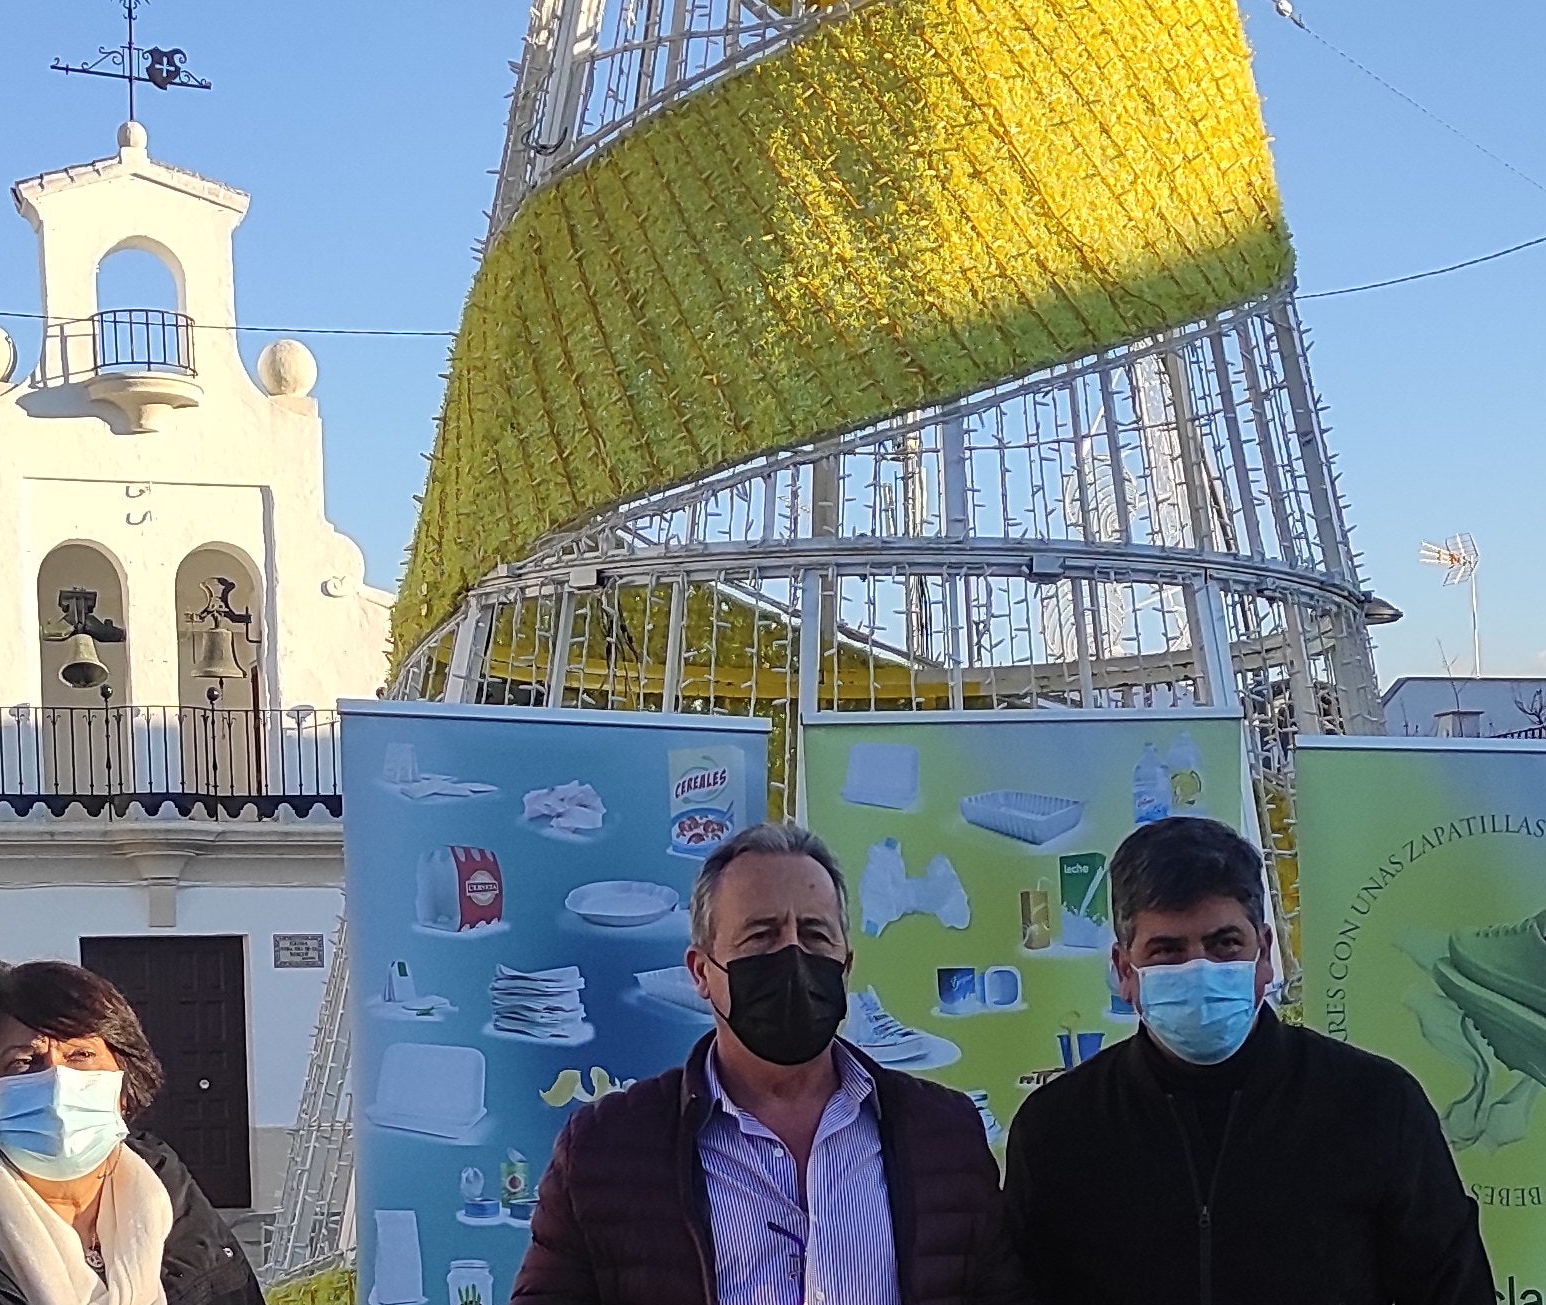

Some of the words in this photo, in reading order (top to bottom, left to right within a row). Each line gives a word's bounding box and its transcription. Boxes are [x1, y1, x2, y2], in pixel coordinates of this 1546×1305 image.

[675, 768, 727, 799] CEREALES
[1402, 814, 1546, 863] ZAPATILLAS
[1351, 854, 1404, 915] UNAS
[1329, 919, 1360, 980] CON
[1327, 988, 1348, 1041] RES
[1470, 1182, 1542, 1206] BEBES
